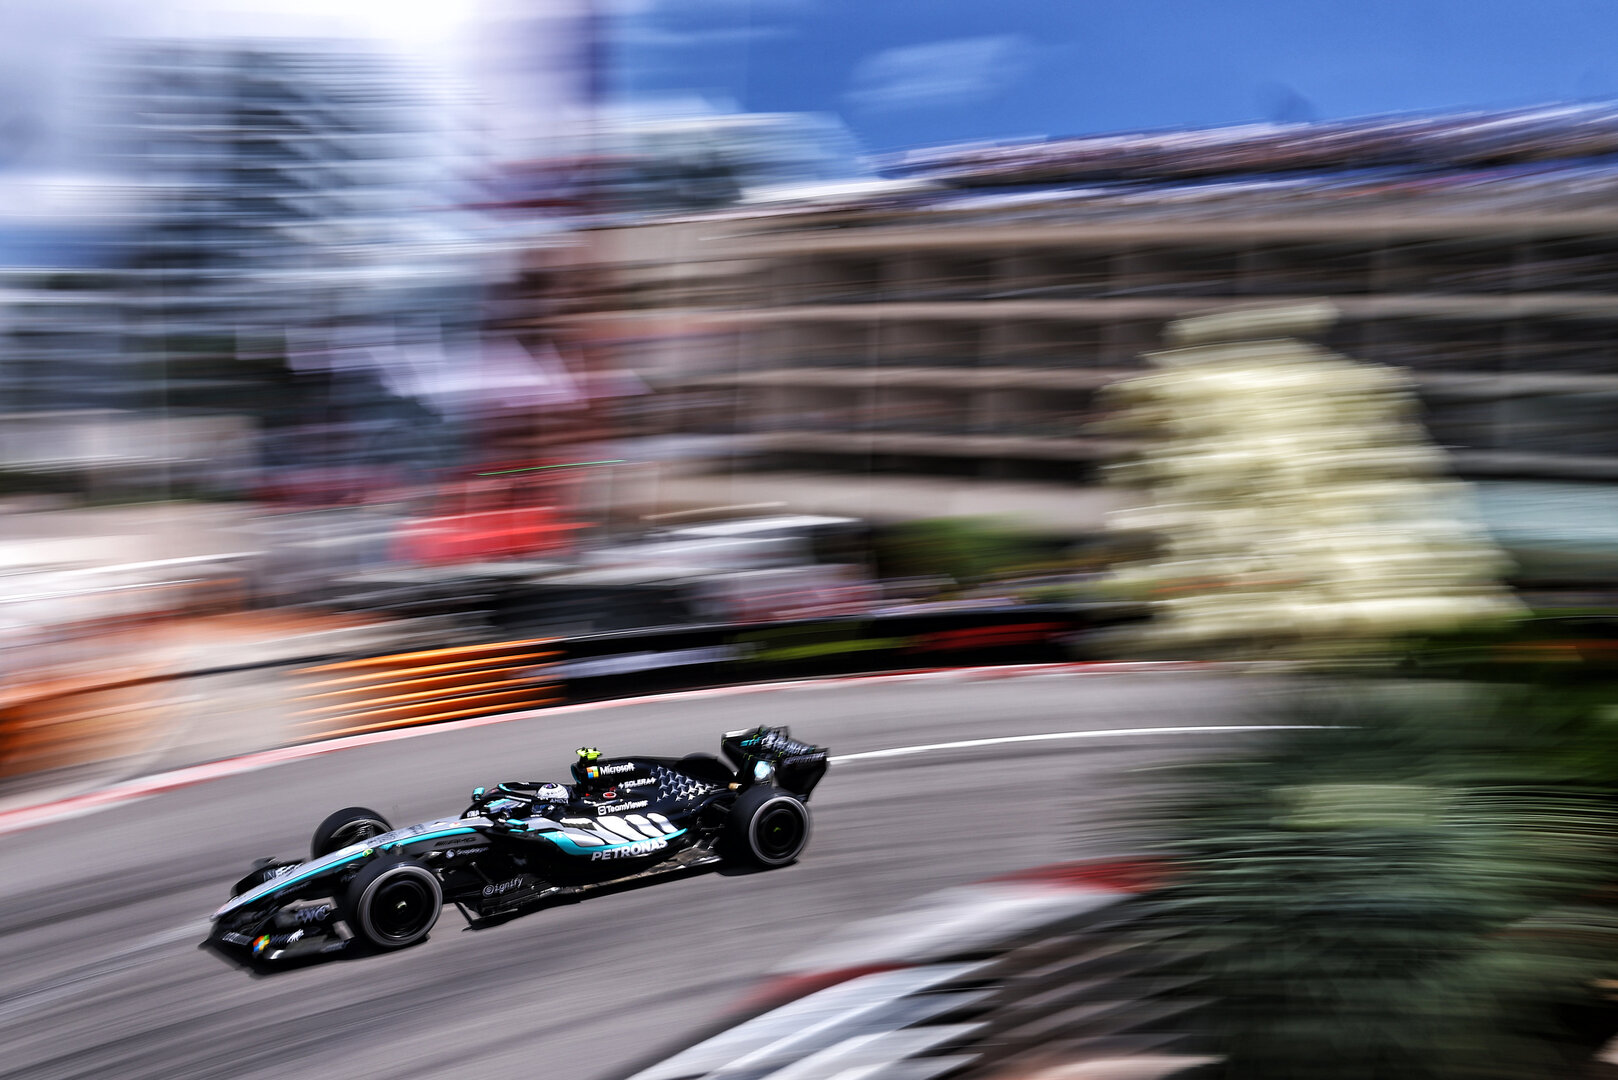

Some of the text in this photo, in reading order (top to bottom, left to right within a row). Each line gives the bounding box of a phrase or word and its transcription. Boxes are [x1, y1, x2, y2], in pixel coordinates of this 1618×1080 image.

[600, 762, 636, 775] Microsoft
[606, 800, 649, 813] TeamViewer
[591, 837, 668, 861] PETRONAS
